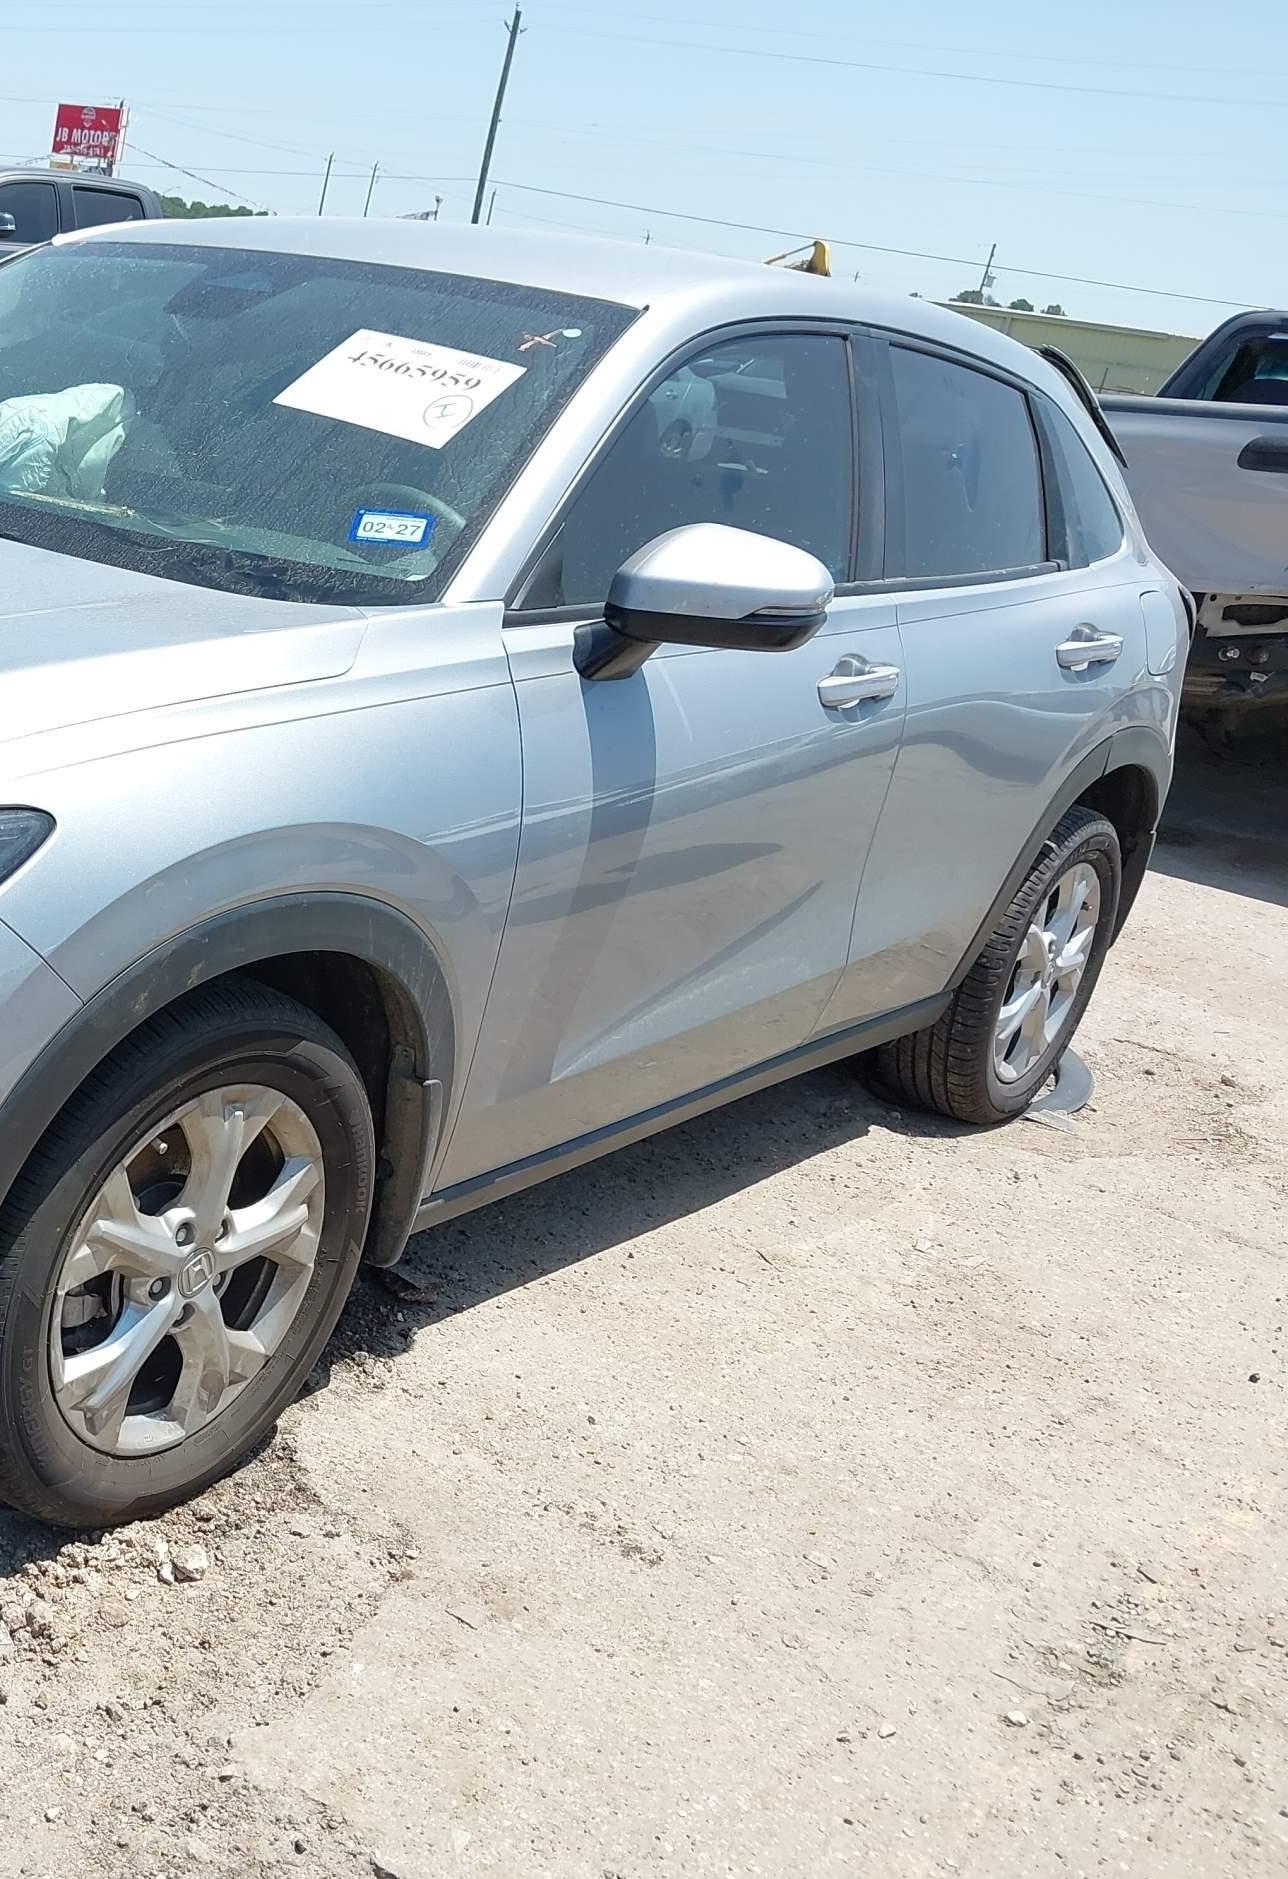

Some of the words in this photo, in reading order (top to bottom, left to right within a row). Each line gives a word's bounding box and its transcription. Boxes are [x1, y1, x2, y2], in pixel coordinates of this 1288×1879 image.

[56, 127, 69, 142] JB
[347, 350, 482, 391] 45665959
[362, 521, 386, 534] 02
[395, 523, 421, 536] 27
